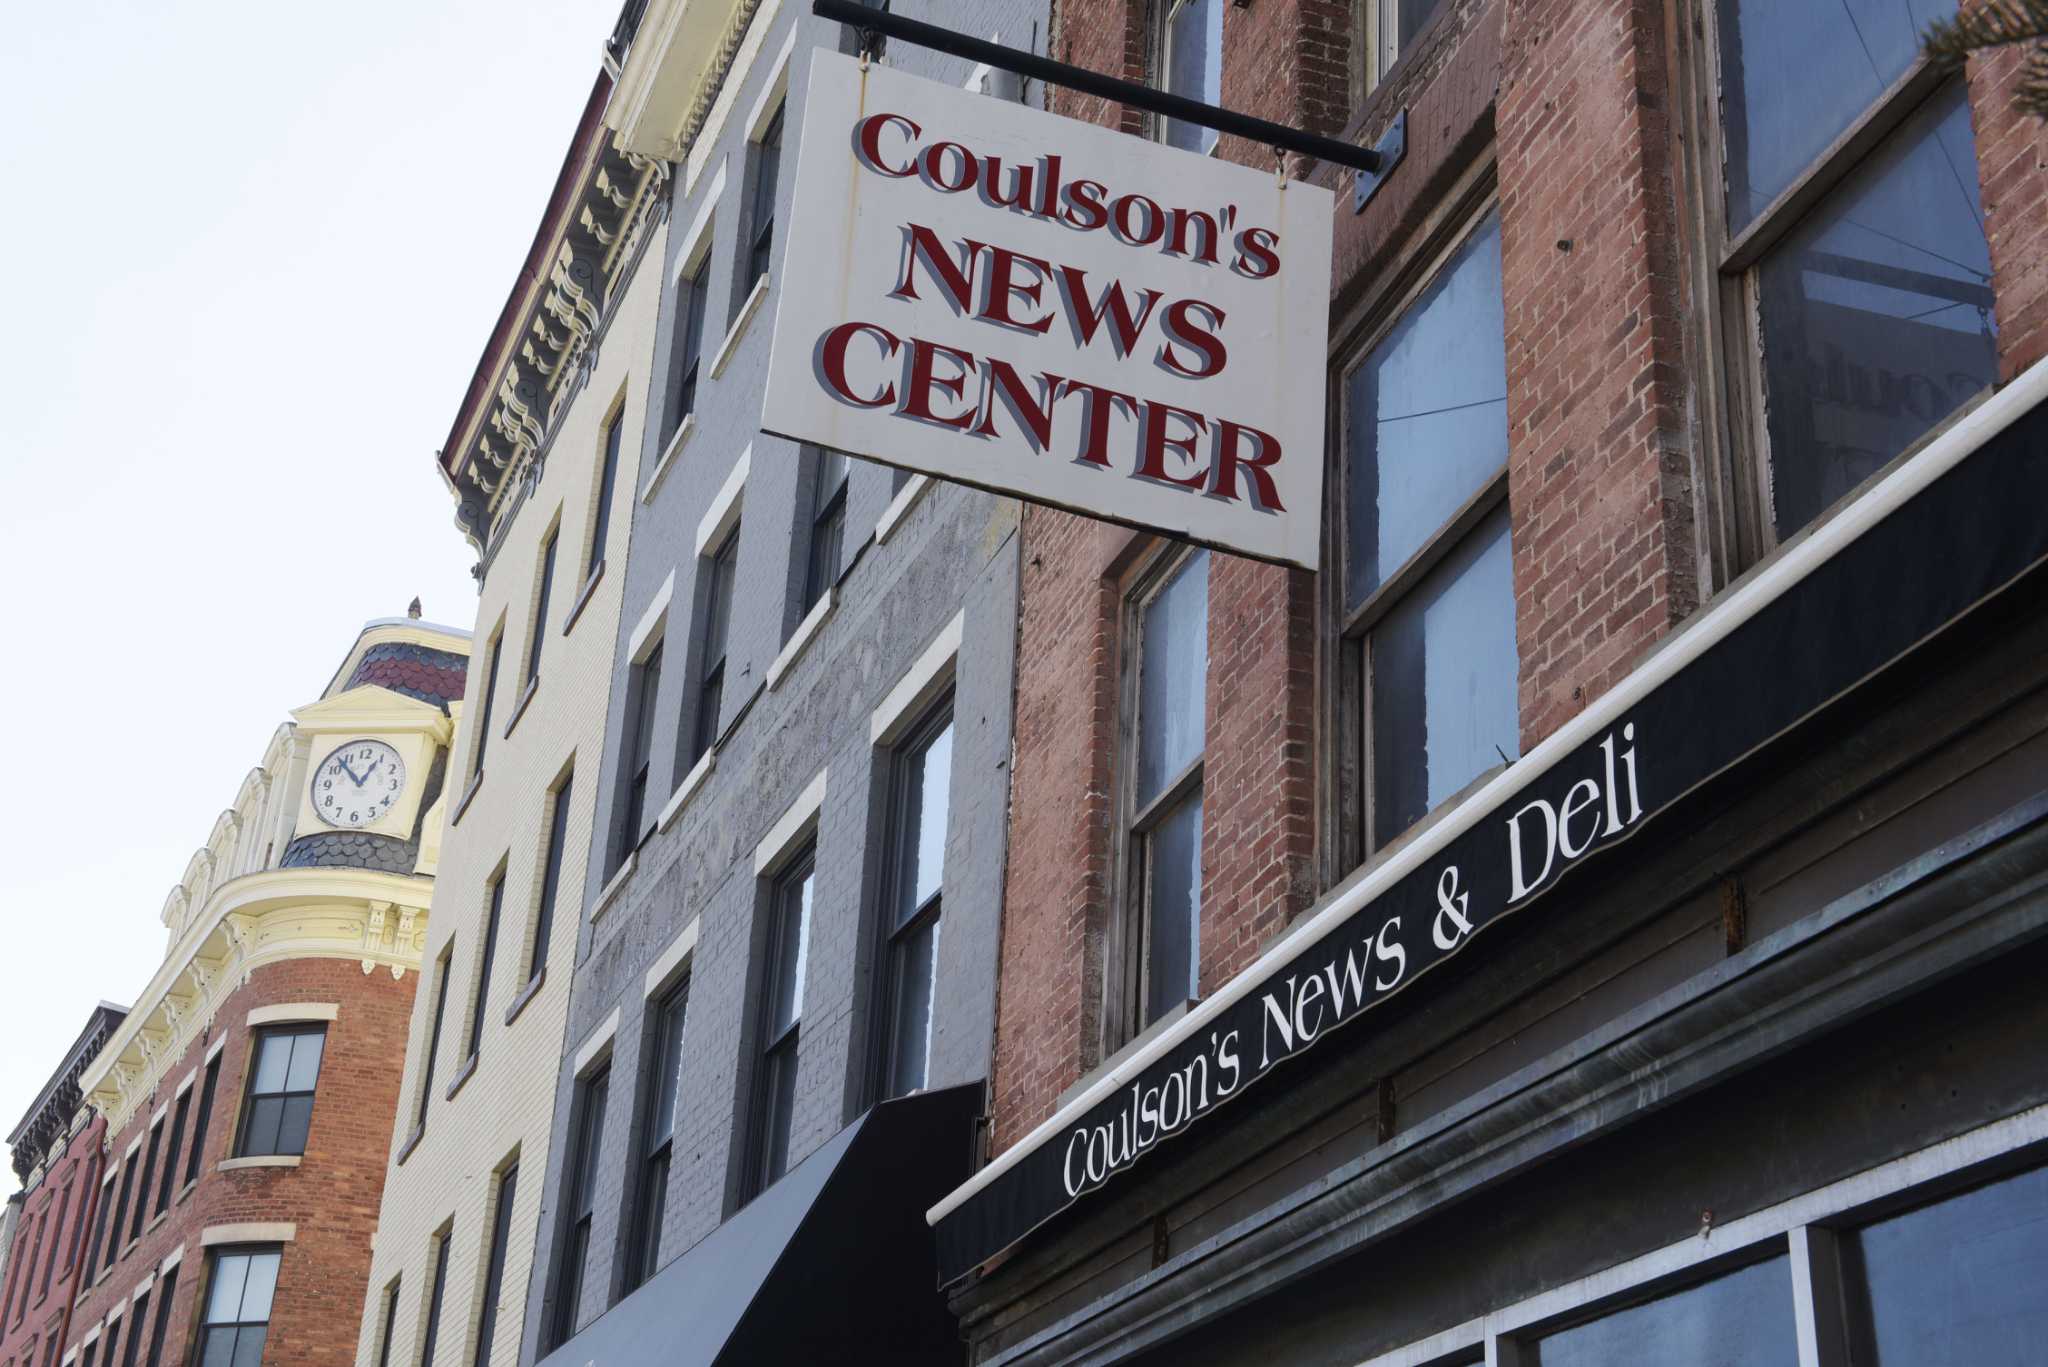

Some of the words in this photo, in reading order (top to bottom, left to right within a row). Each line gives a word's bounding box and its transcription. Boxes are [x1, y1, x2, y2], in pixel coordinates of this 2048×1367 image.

[852, 112, 1281, 279] Coulson's
[886, 222, 1228, 378] NEWS
[812, 321, 1287, 514] CENTER
[344, 754, 354, 764] 11
[360, 748, 373, 760] 12
[379, 753, 385, 764] 1
[329, 765, 341, 776] 10
[388, 763, 397, 775] 2
[323, 780, 332, 791] 9
[389, 779, 398, 791] 3
[324, 795, 333, 808] 8
[380, 795, 390, 807] 4
[335, 806, 343, 818] 7
[350, 811, 359, 822] 6
[367, 806, 376, 818] 5
[1063, 1030, 1241, 1197] Coulson's
[1258, 915, 1407, 1071] News
[1431, 865, 1474, 950] &
[1505, 721, 1643, 904] Deli
